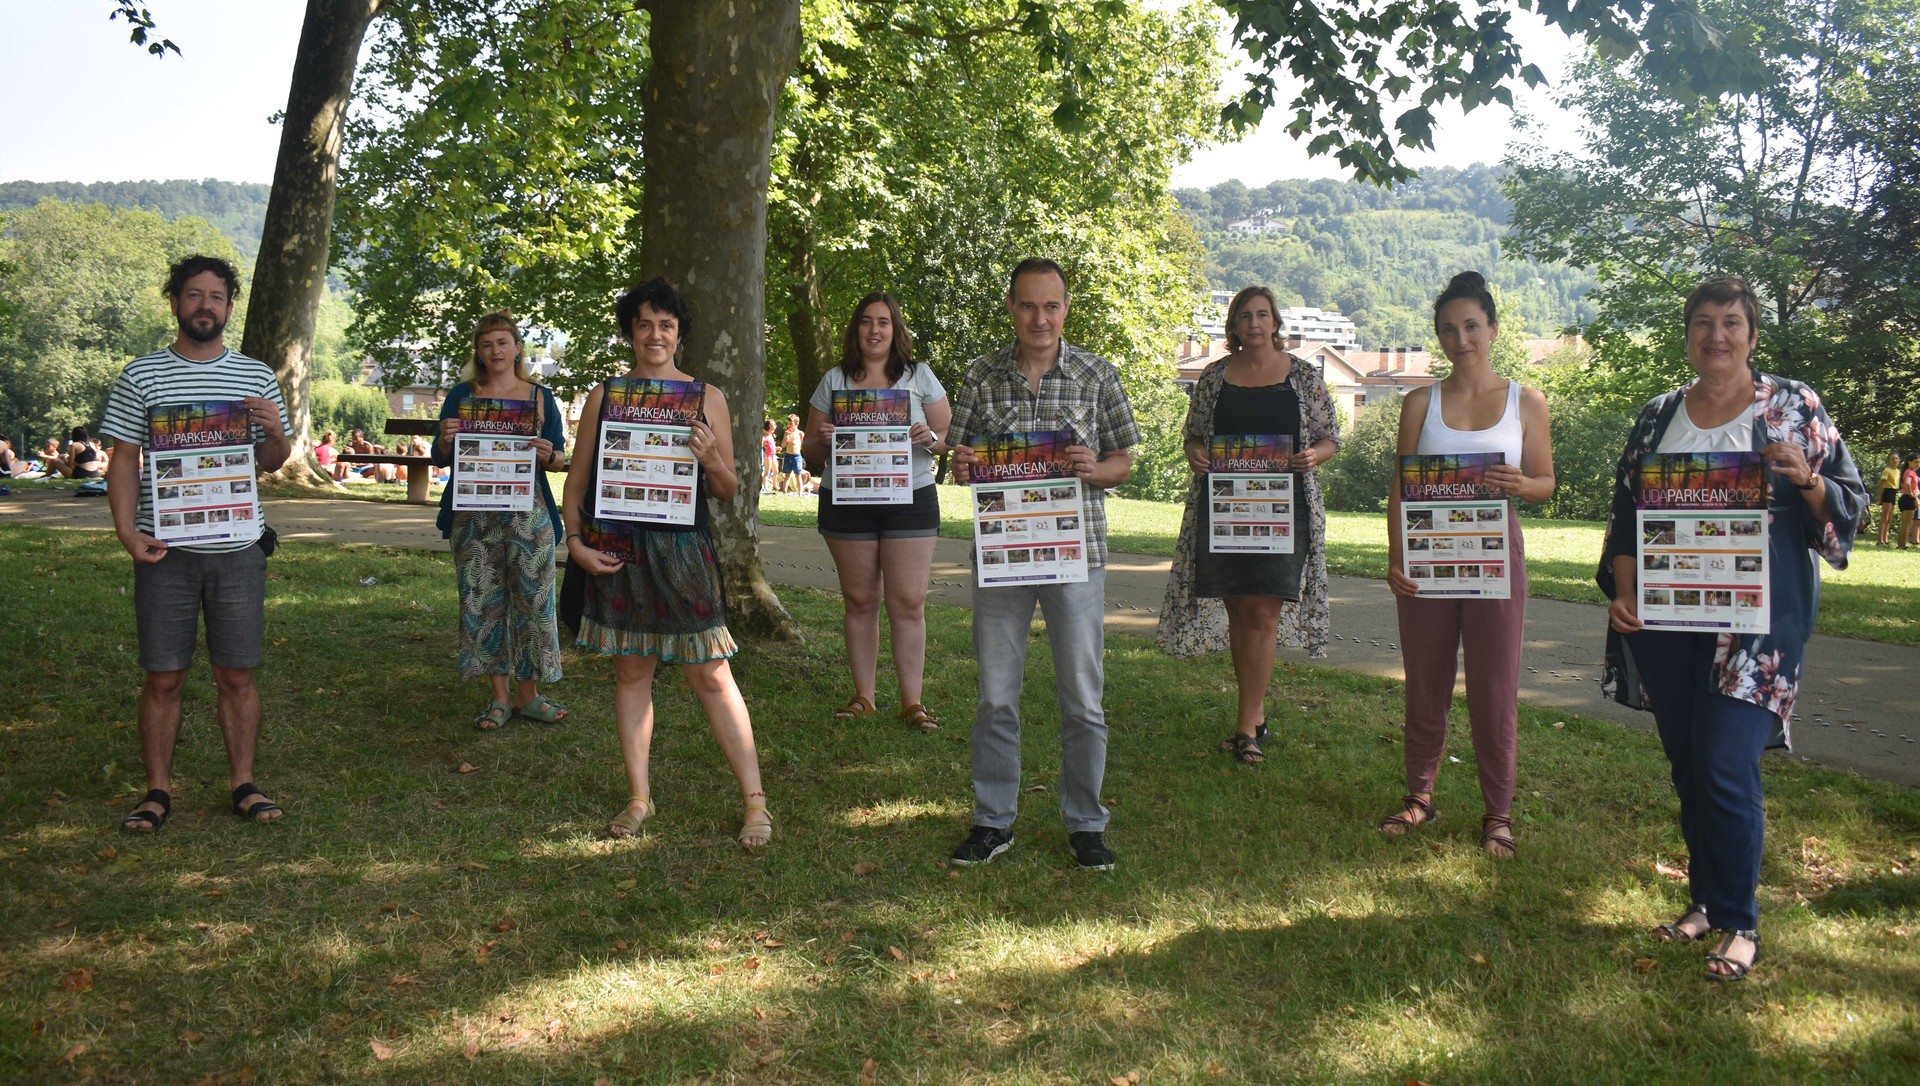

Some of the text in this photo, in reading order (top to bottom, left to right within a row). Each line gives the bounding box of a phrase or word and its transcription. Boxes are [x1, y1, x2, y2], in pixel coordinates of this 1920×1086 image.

[608, 405, 698, 421] UDAPARKEAN2022
[835, 413, 907, 422] UDAPARKEAN2022
[154, 428, 246, 446] UDAPARKEAN2022
[974, 461, 1073, 478] UDAPARKEAN2022
[1213, 459, 1288, 469] UDAPARKEAN2022
[1642, 488, 1760, 503] UDAPARKEAN2022
